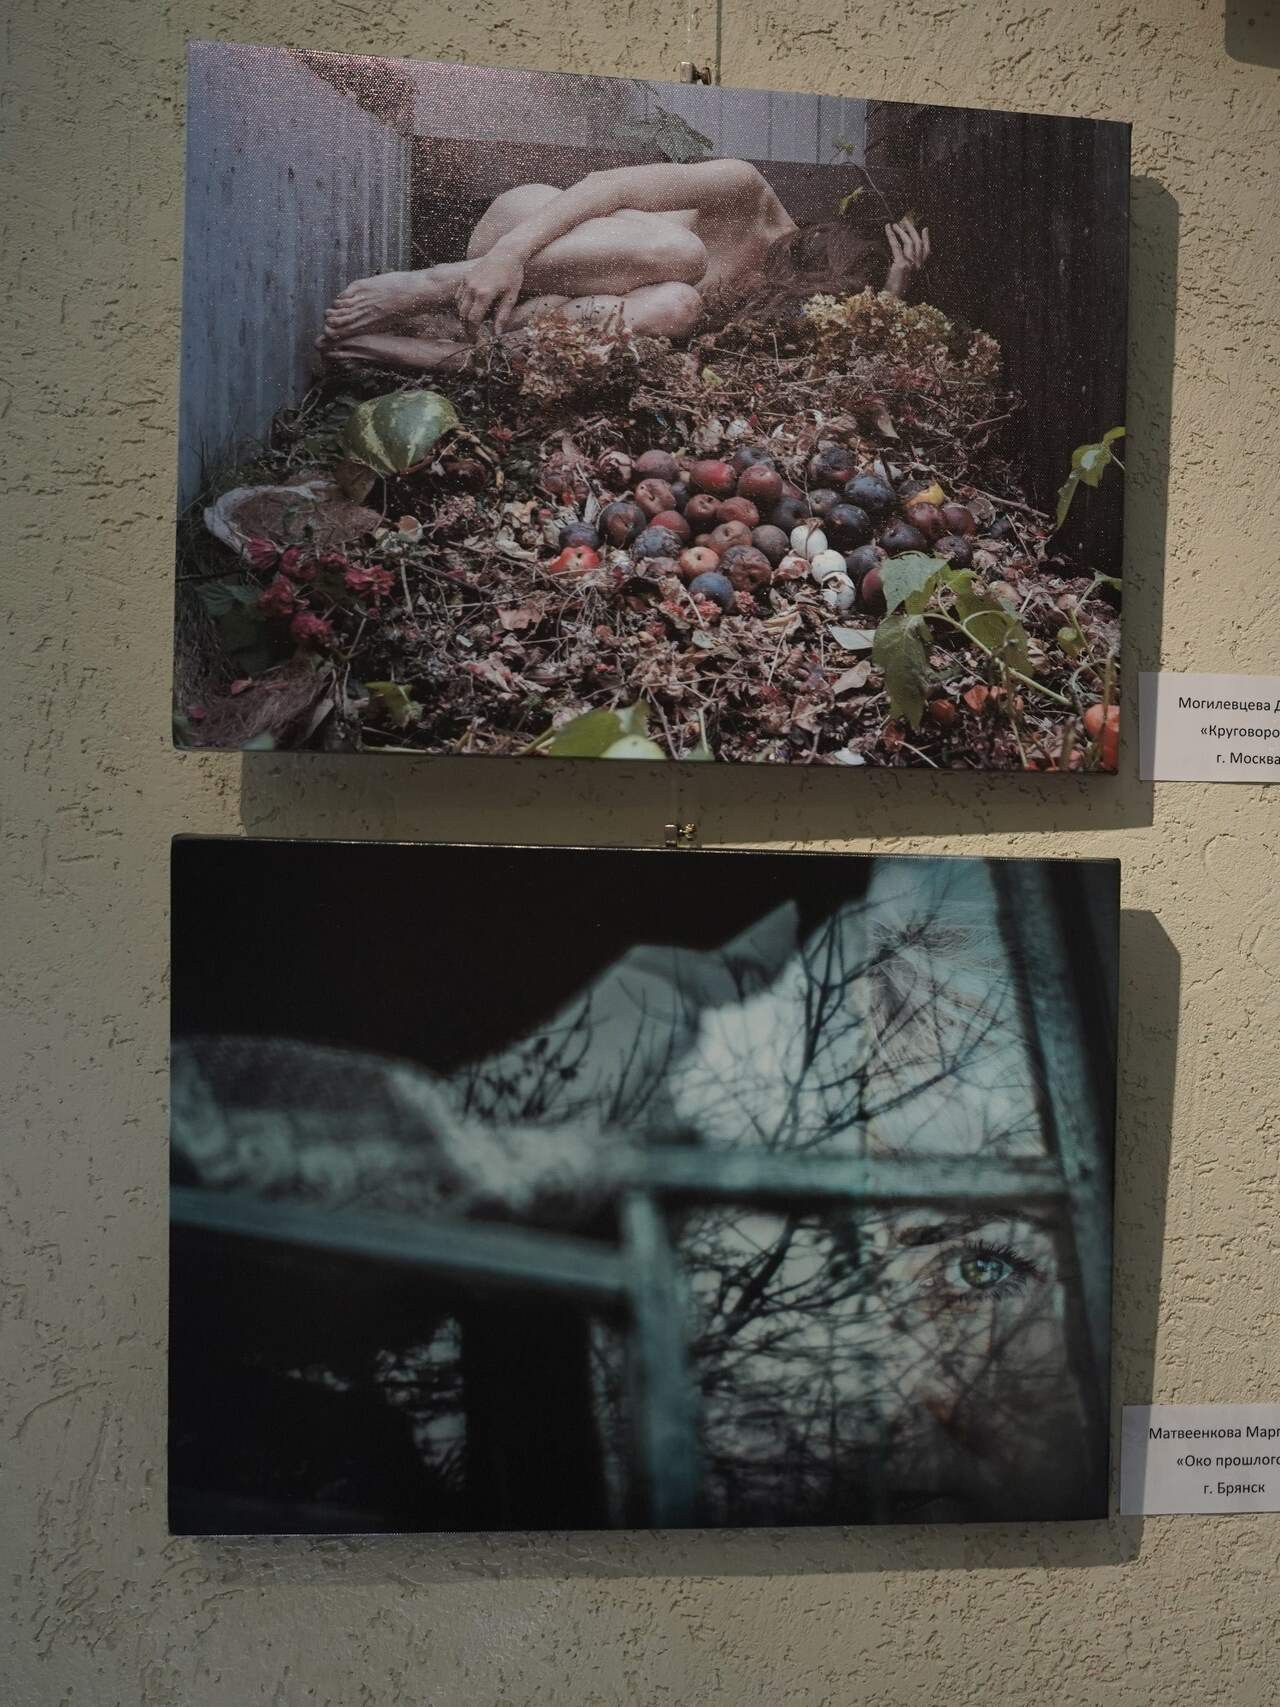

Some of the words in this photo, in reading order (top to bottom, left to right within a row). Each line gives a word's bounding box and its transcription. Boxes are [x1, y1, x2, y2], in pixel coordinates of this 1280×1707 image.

[1178, 697, 1271, 712] Могилевцева
[1216, 754, 1225, 764] г.
[1230, 752, 1280, 765] Москва
[1149, 1427, 1241, 1440] Матвеенкова
[1176, 1455, 1212, 1467] «Око
[1203, 1485, 1213, 1495] г.
[1217, 1482, 1266, 1497] Брянск
